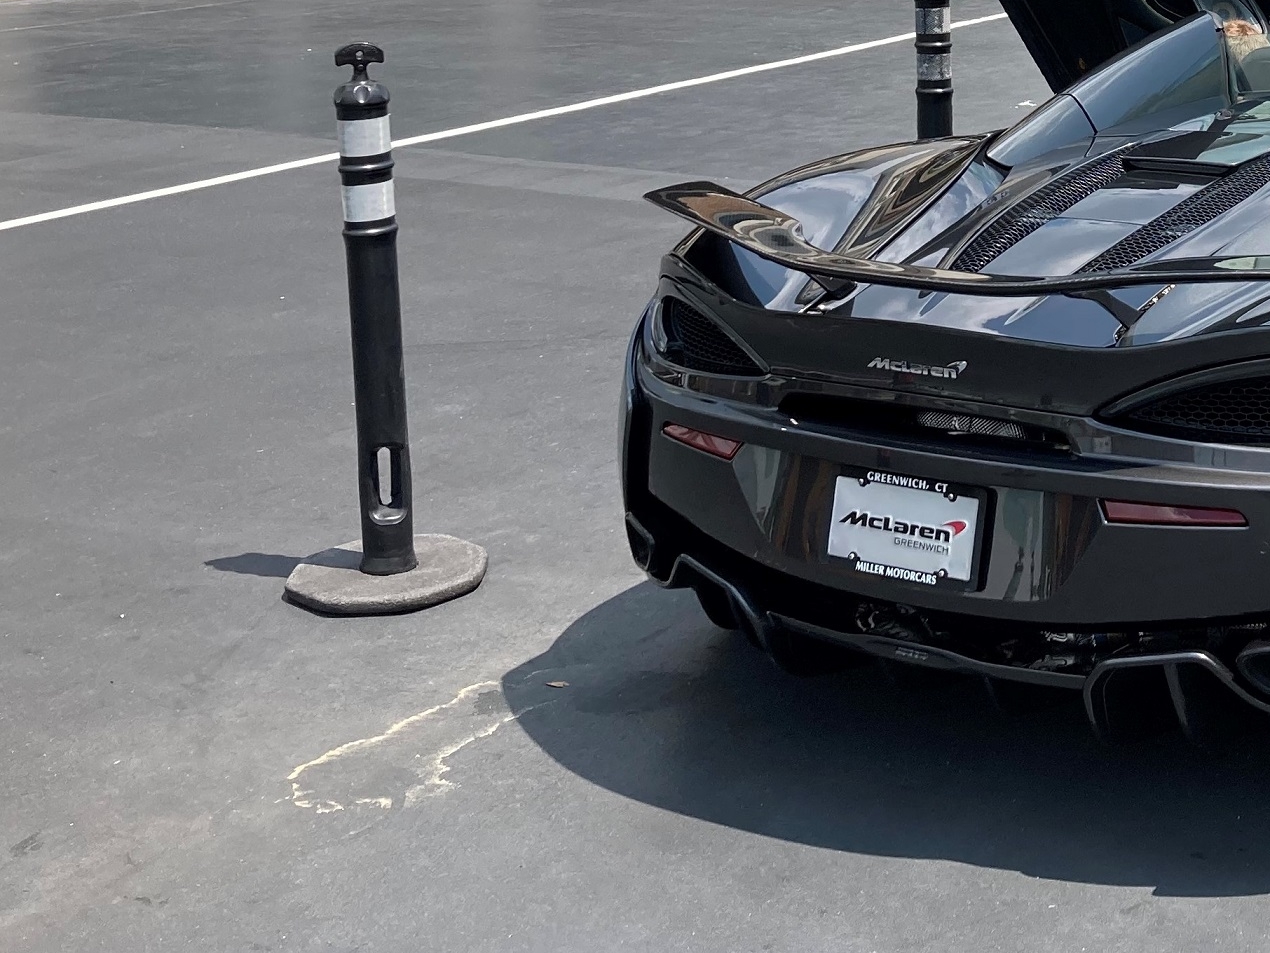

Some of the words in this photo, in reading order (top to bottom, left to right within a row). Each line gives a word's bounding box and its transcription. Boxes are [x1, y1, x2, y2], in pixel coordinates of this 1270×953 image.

[867, 357, 957, 379] McLaren
[867, 471, 930, 490] GREENWICH,
[935, 482, 949, 494] CT
[839, 510, 950, 543] McLaren
[894, 536, 949, 556] GREENWICH
[855, 561, 885, 576] MILLER
[885, 566, 937, 585] MOTORCARS
